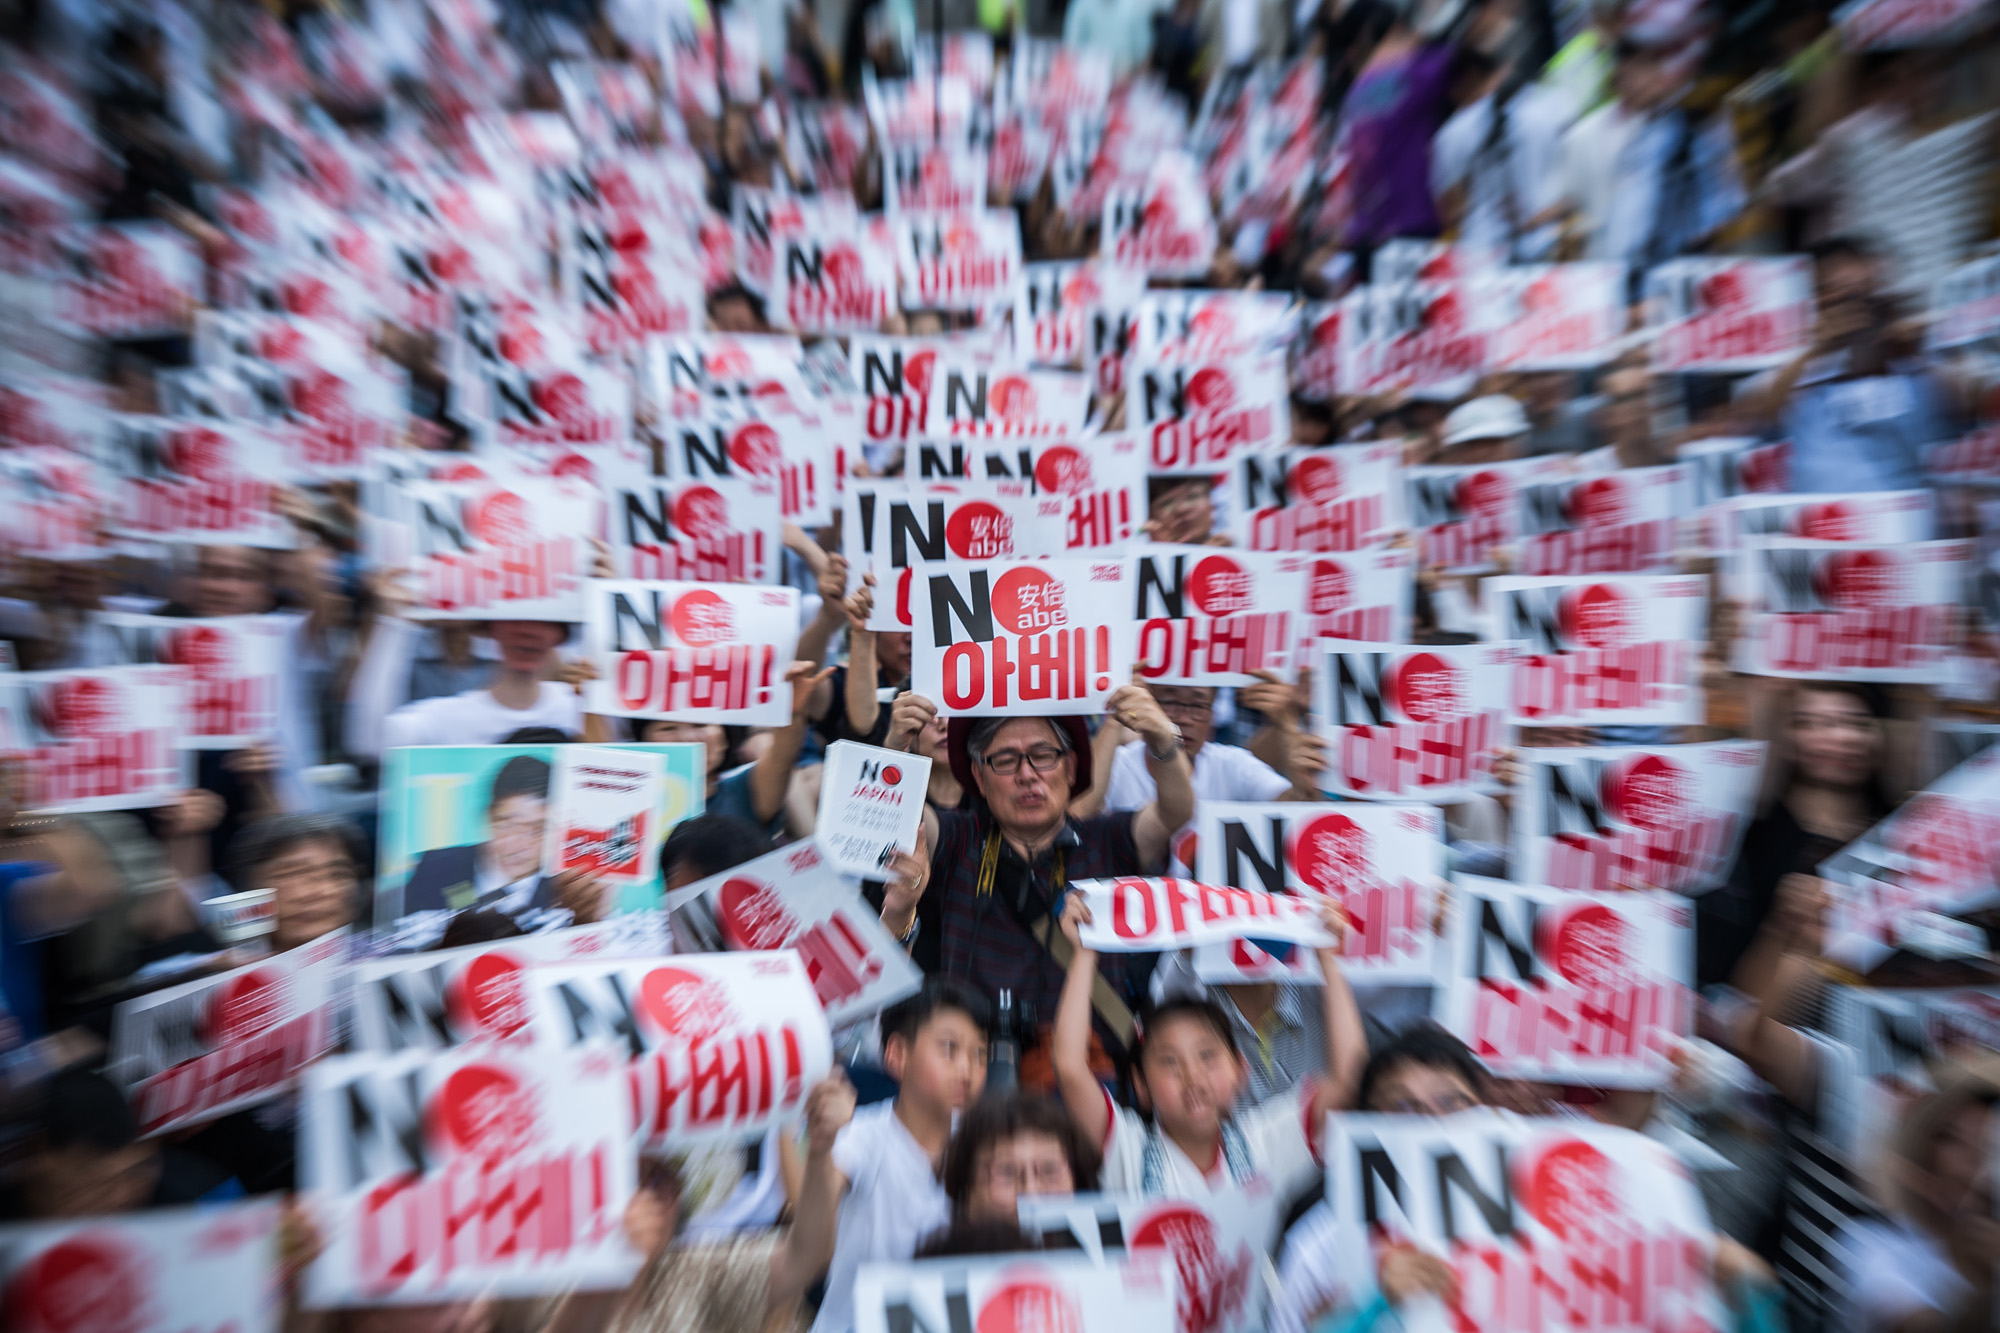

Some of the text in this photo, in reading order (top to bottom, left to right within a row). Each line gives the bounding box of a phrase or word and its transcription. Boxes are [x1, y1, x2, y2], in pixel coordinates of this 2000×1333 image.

[1017, 579, 1066, 609] 安倍
[1017, 608, 1067, 630] abe
[617, 645, 777, 711] 아베!
[942, 624, 1110, 711] 아베!
[850, 783, 904, 807] JAPAN
